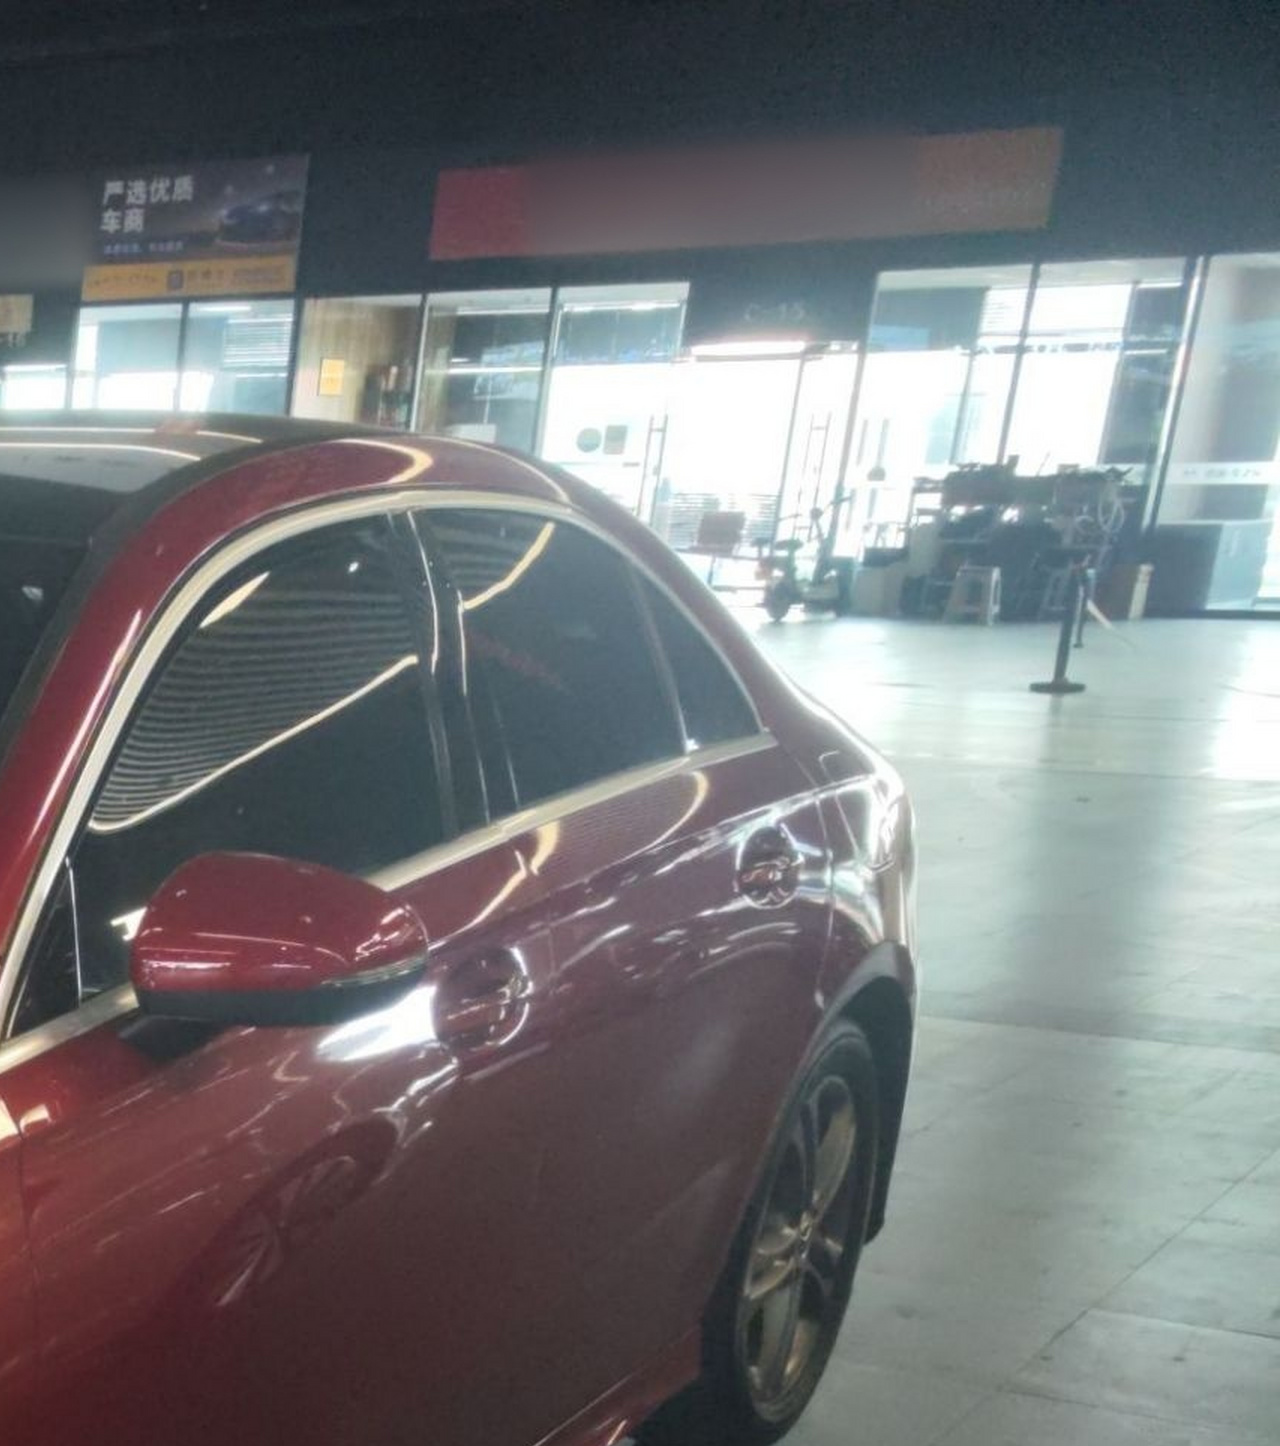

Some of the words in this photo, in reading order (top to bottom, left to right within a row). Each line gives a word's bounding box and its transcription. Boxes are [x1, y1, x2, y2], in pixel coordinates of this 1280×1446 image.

[102, 174, 195, 206] 严选优质
[99, 207, 146, 234] 车商
